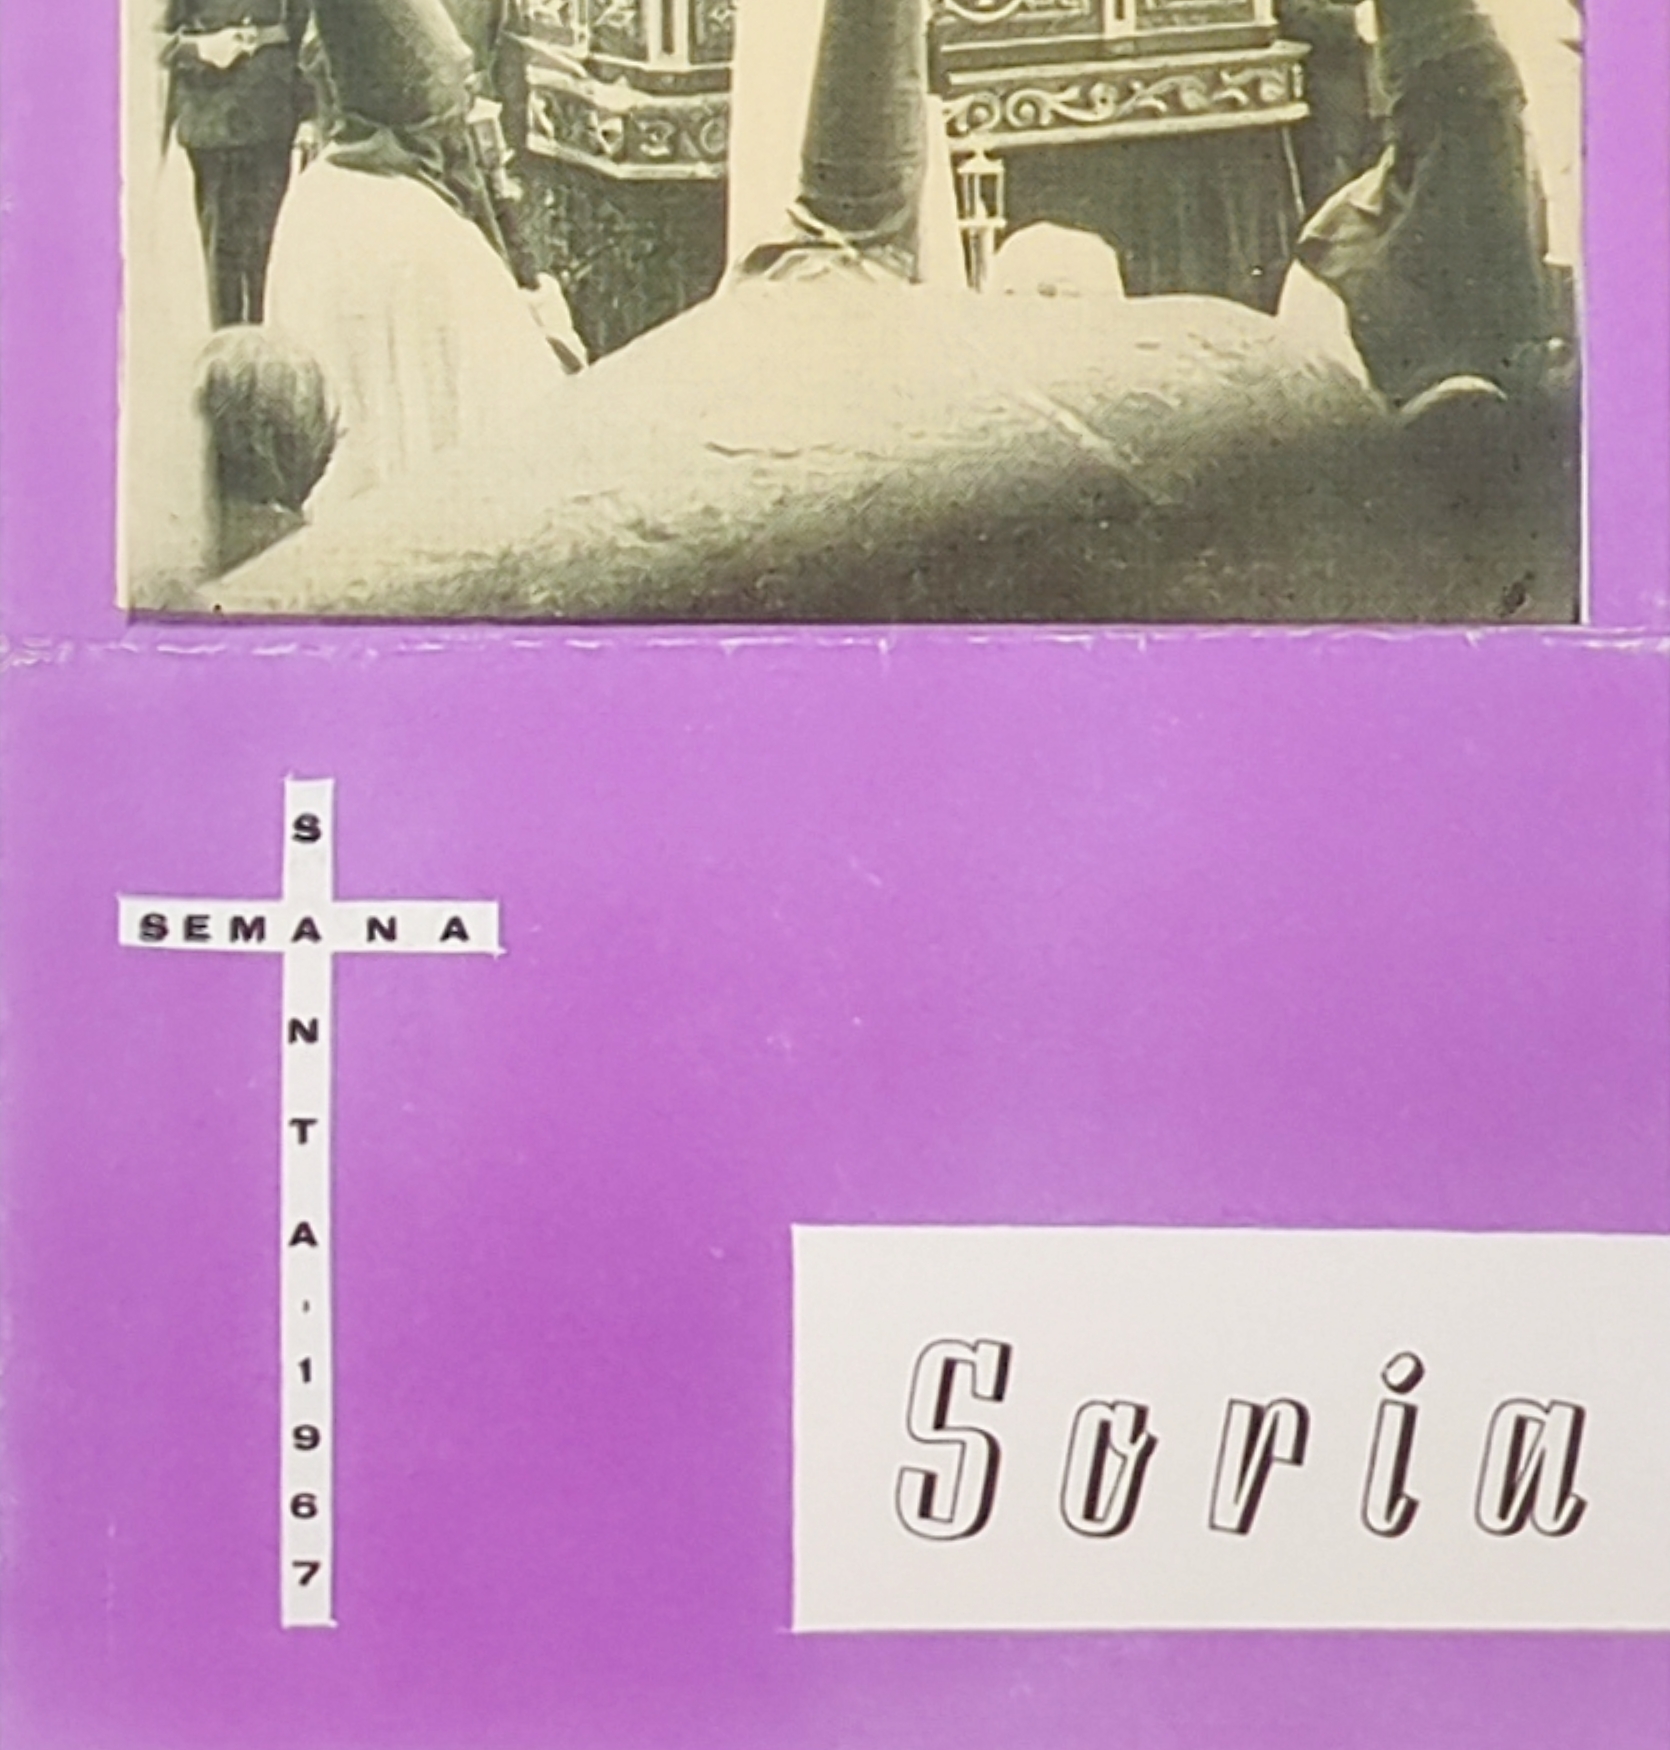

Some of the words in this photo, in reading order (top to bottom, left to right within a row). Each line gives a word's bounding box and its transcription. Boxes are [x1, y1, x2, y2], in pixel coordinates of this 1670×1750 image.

[140, 912, 470, 942] SEMANA
[290, 814, 322, 1247] SANTA
[291, 1357, 320, 1587] 1967
[895, 1338, 1588, 1542] Soria
